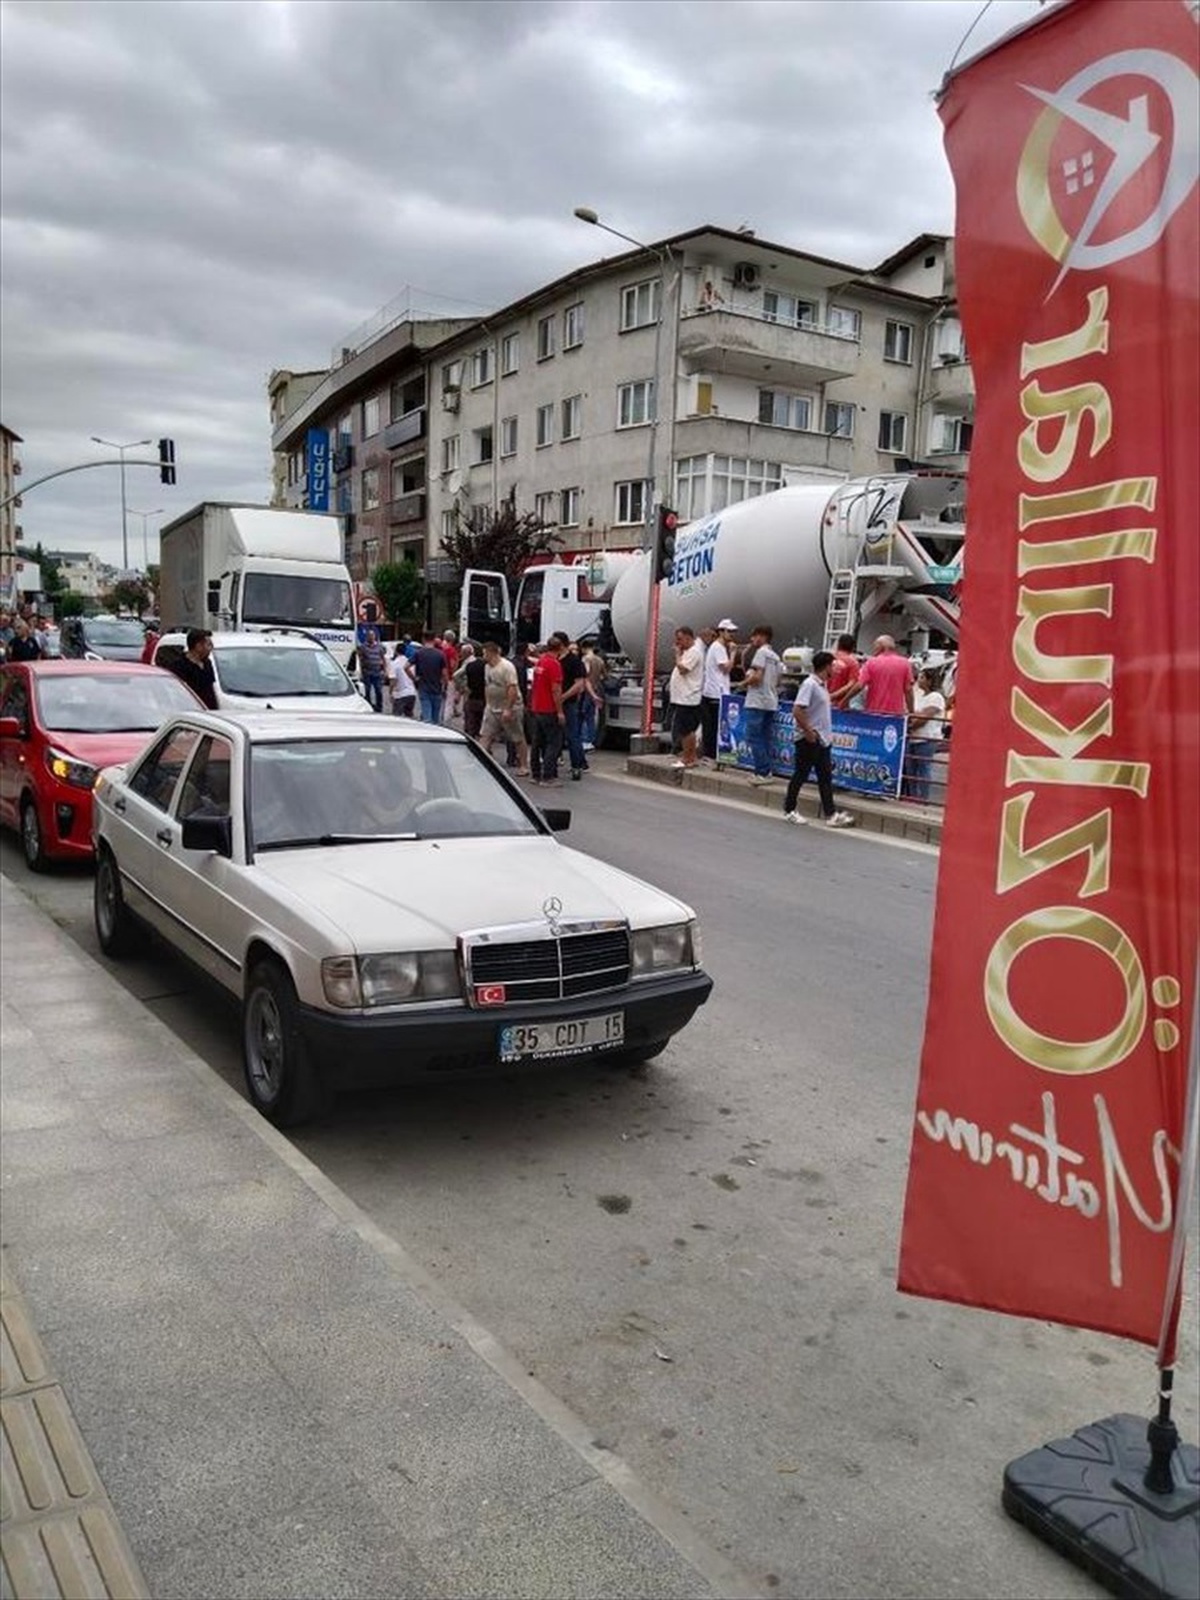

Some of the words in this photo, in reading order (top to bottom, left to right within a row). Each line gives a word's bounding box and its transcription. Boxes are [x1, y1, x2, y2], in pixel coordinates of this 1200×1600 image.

[668, 547, 714, 586] BETON
[515, 1027, 539, 1050] 35
[556, 1021, 589, 1047] CDT
[604, 1015, 621, 1039] 15
